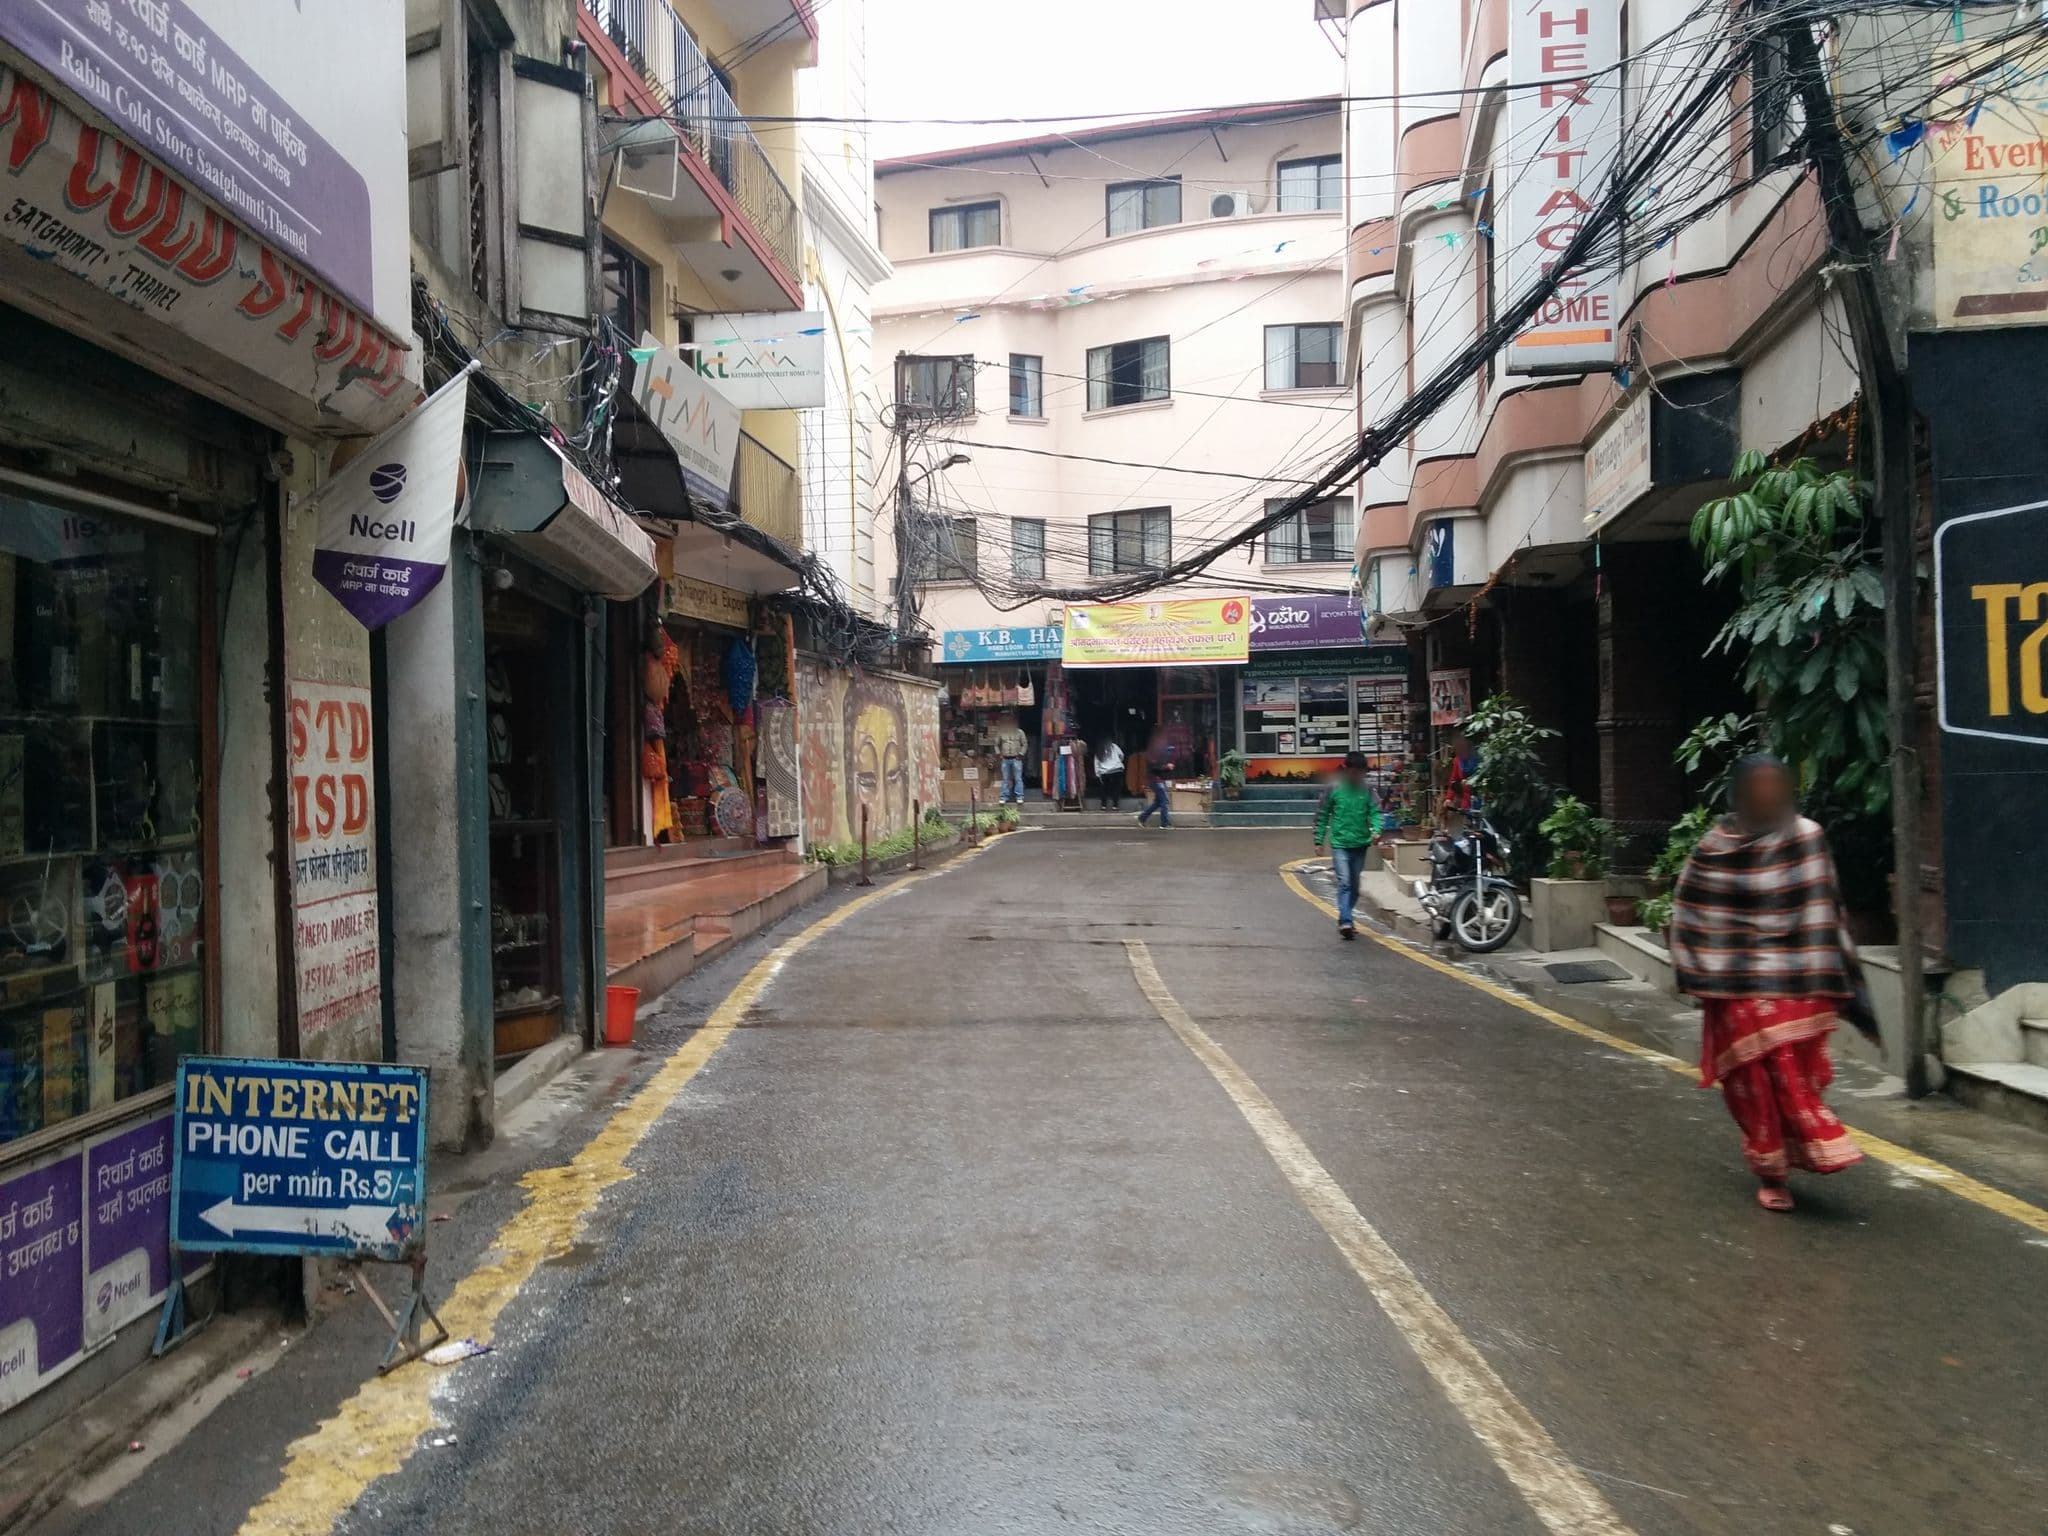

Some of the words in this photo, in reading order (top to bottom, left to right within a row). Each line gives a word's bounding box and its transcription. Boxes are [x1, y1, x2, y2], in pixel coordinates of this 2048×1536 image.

[61, 39, 112, 104] Rabin
[115, 86, 152, 136] Cold
[156, 117, 194, 165] Store
[211, 57, 247, 108] MRP
[1963, 135, 2048, 172] Ever
[121, 263, 182, 312] THAMEL
[349, 513, 415, 544] Ncell
[291, 697, 370, 763] STD
[293, 774, 369, 843] ISD
[185, 1073, 419, 1124] INTERNET
[188, 1121, 310, 1159] PHONE
[324, 1130, 411, 1163] CALL
[242, 1170, 281, 1201] per
[113, 1271, 142, 1301] Ncell
